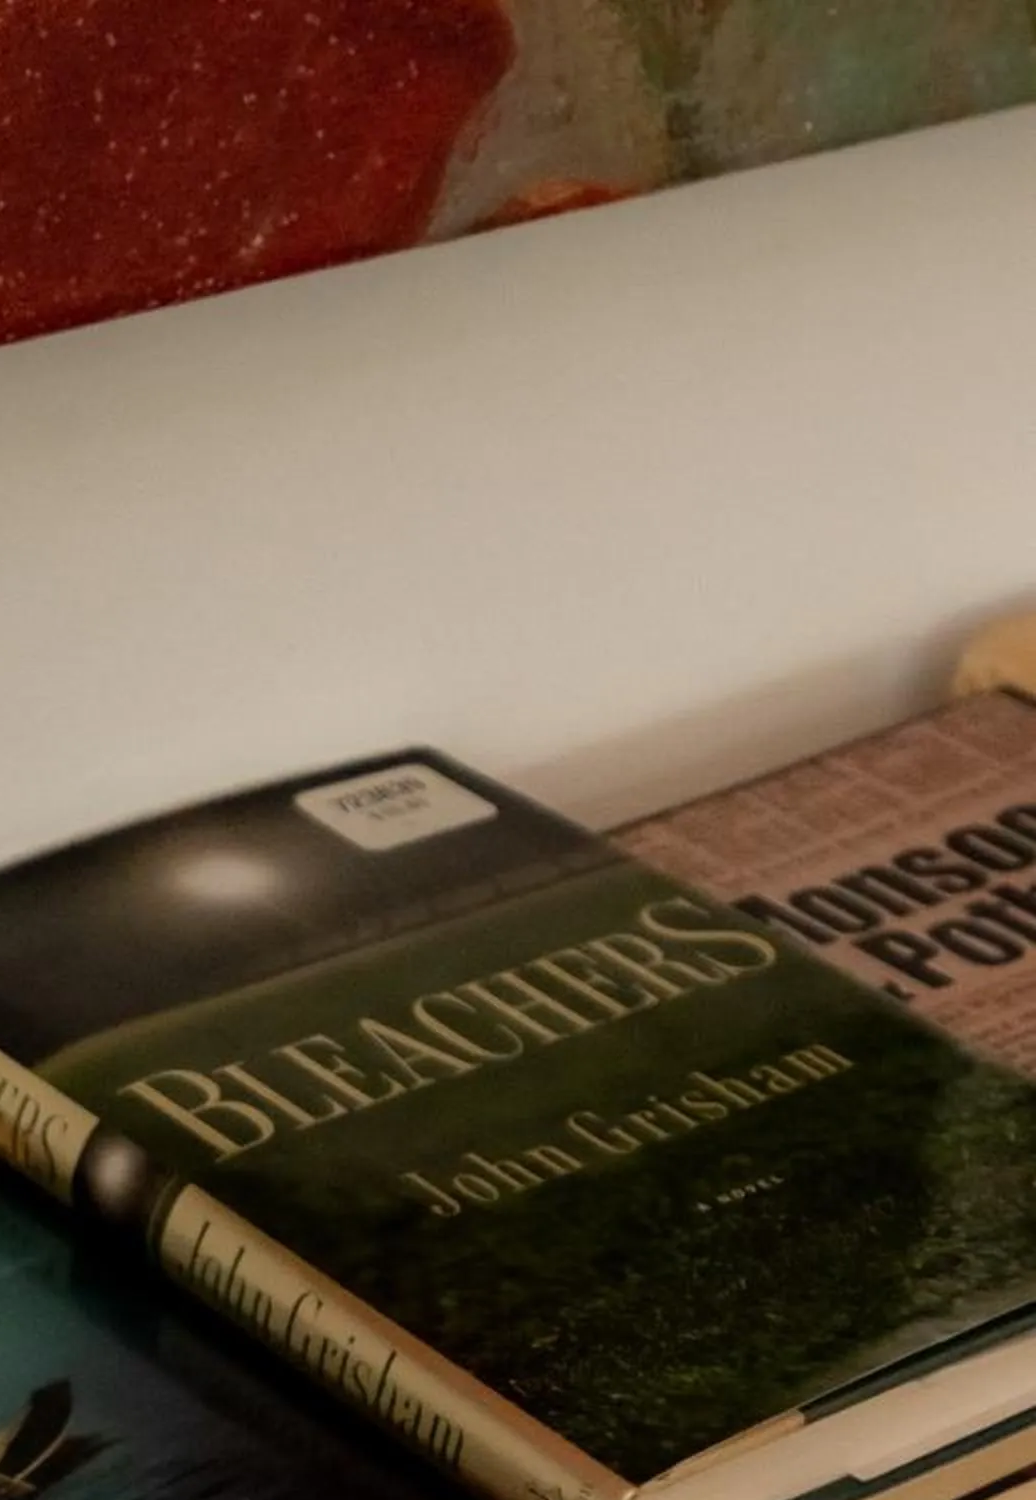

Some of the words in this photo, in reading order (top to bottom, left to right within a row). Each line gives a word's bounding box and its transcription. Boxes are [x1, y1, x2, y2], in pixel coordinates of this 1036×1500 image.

[116, 897, 777, 1164] BLEACHERS
[400, 1130, 584, 1218] John
[567, 1040, 856, 1158] Grisham
[177, 1220, 273, 1338] John
[284, 1290, 465, 1471] Grisham
